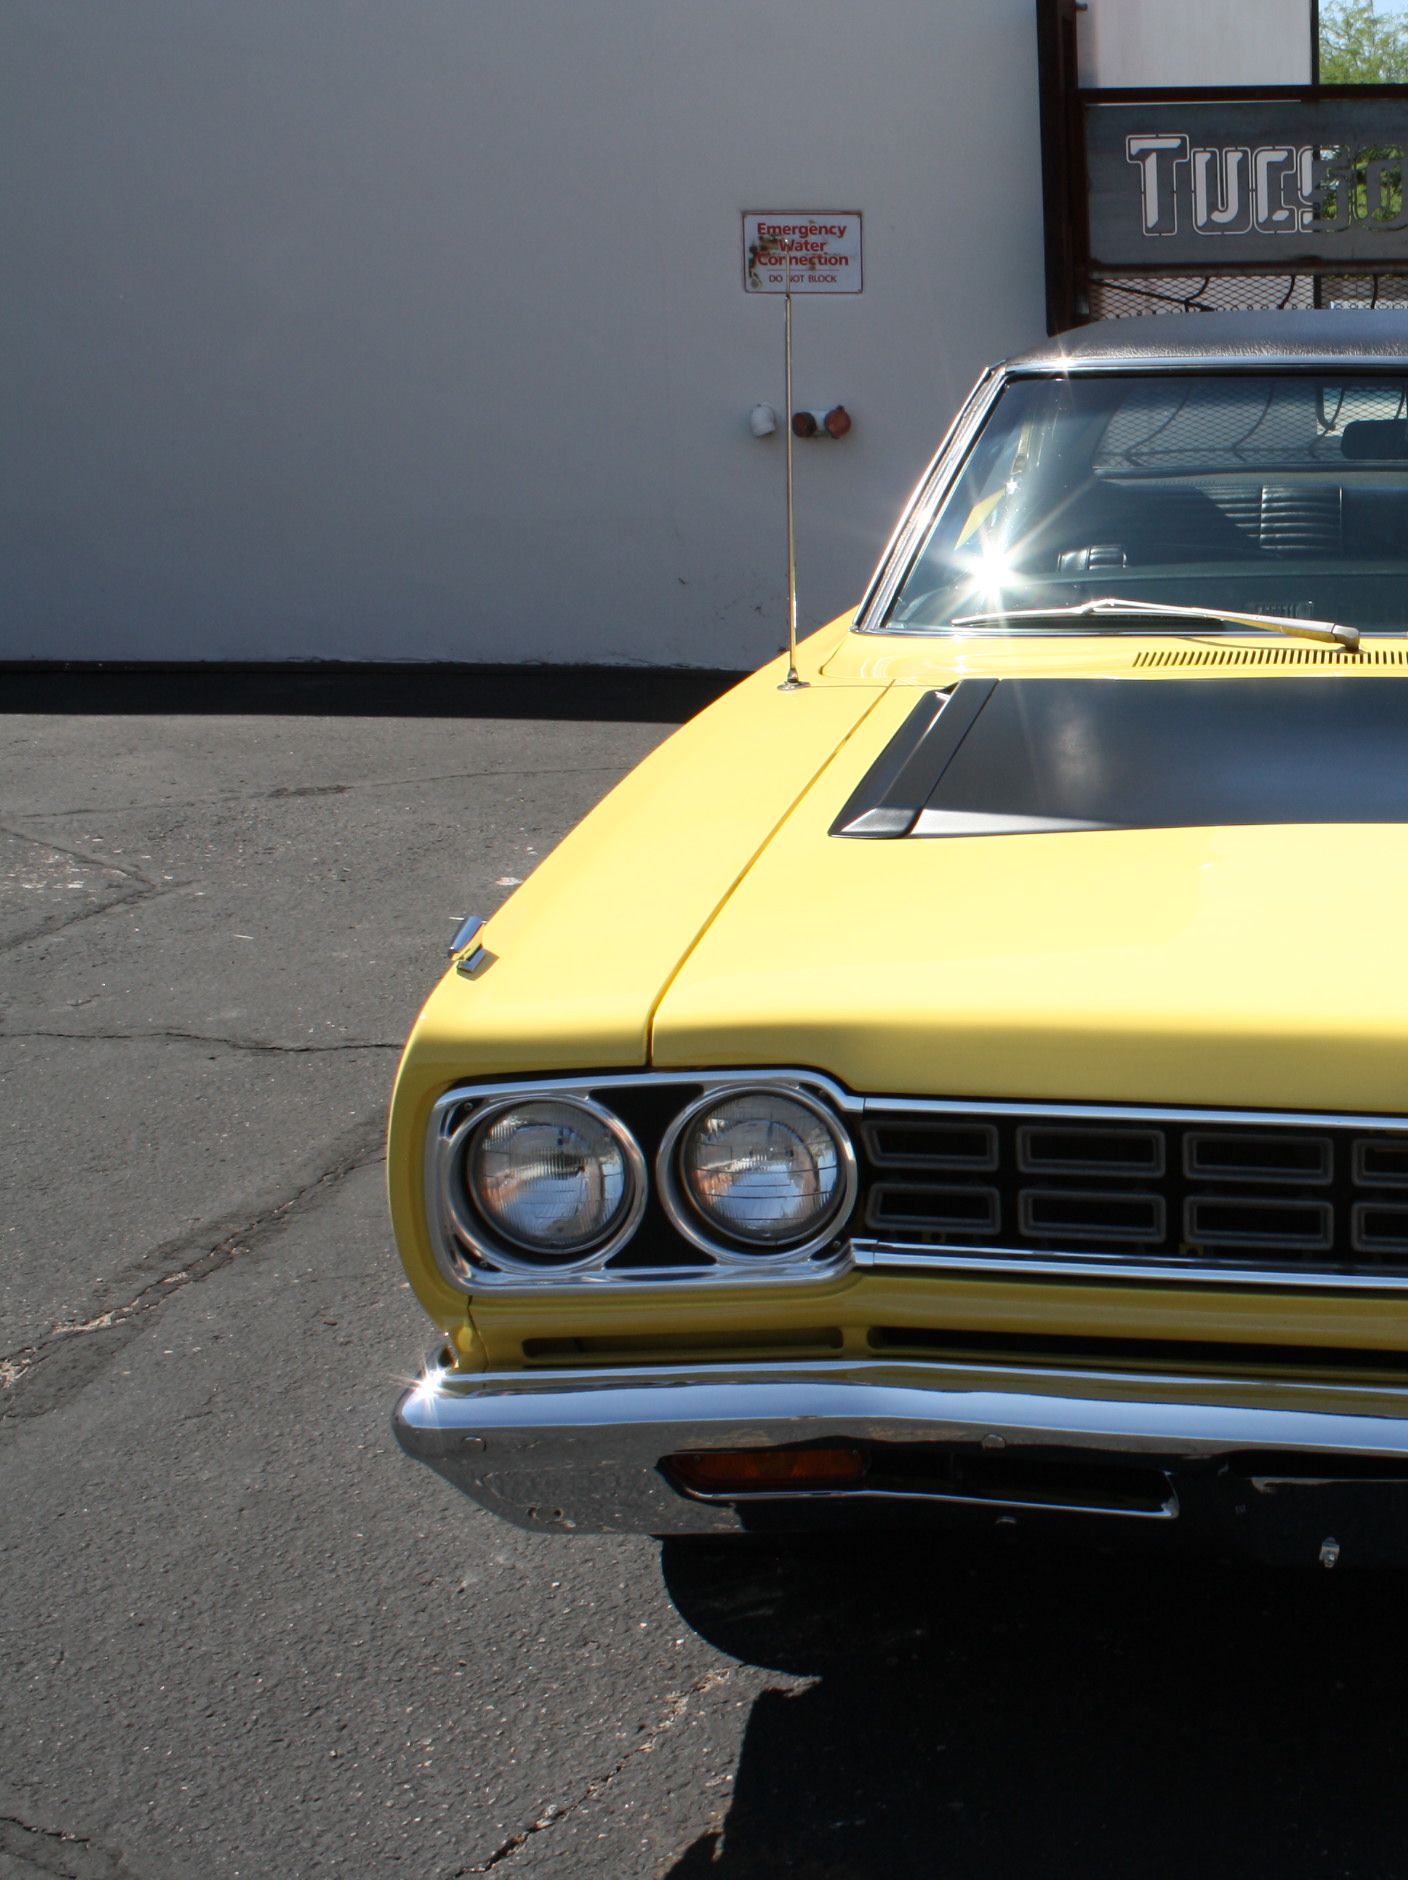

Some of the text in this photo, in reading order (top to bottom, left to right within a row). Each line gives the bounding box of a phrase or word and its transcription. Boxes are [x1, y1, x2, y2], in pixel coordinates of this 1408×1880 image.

[757, 223, 847, 238] Emergency
[779, 238, 827, 252] Water
[769, 274, 783, 283] DO
[808, 274, 837, 283] BLOCK
